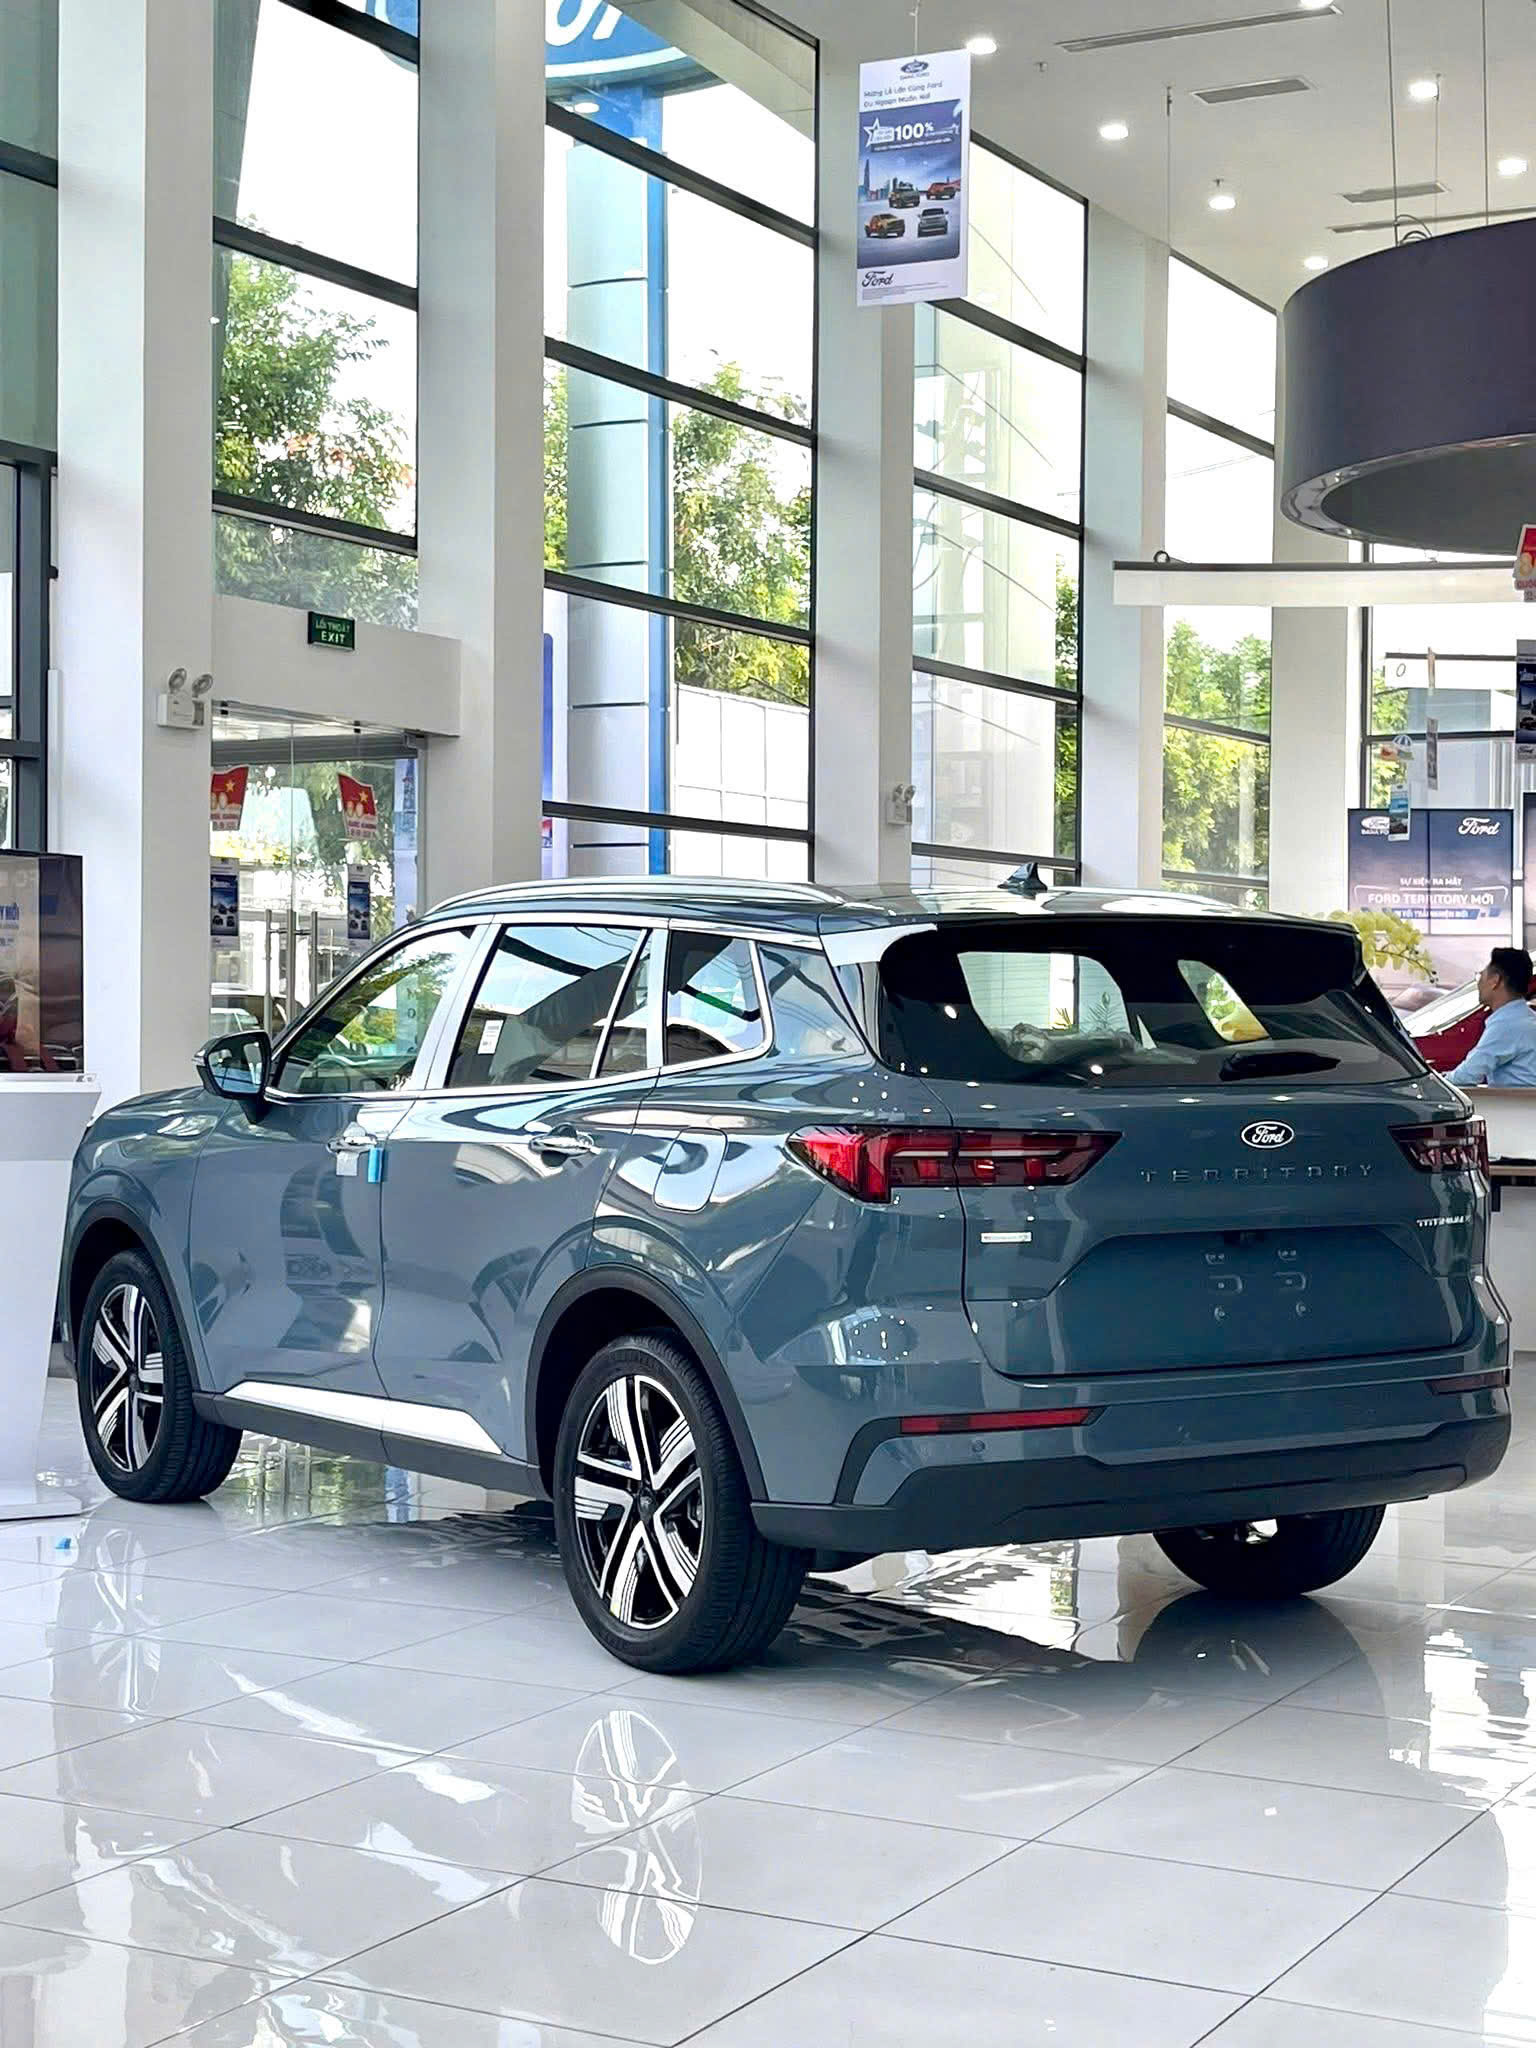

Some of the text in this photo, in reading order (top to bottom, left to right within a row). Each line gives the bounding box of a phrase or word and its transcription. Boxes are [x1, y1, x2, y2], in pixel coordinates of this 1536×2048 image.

[861, 270, 895, 288] Ford
[321, 630, 346, 645] EXIT
[1458, 816, 1500, 836] Ford
[1432, 877, 1444, 886] RA
[1368, 892, 1494, 905] FORD TERRITORY MỚI
[1251, 1124, 1286, 1144] Ford
[1140, 1164, 1376, 1185] TERRITORY
